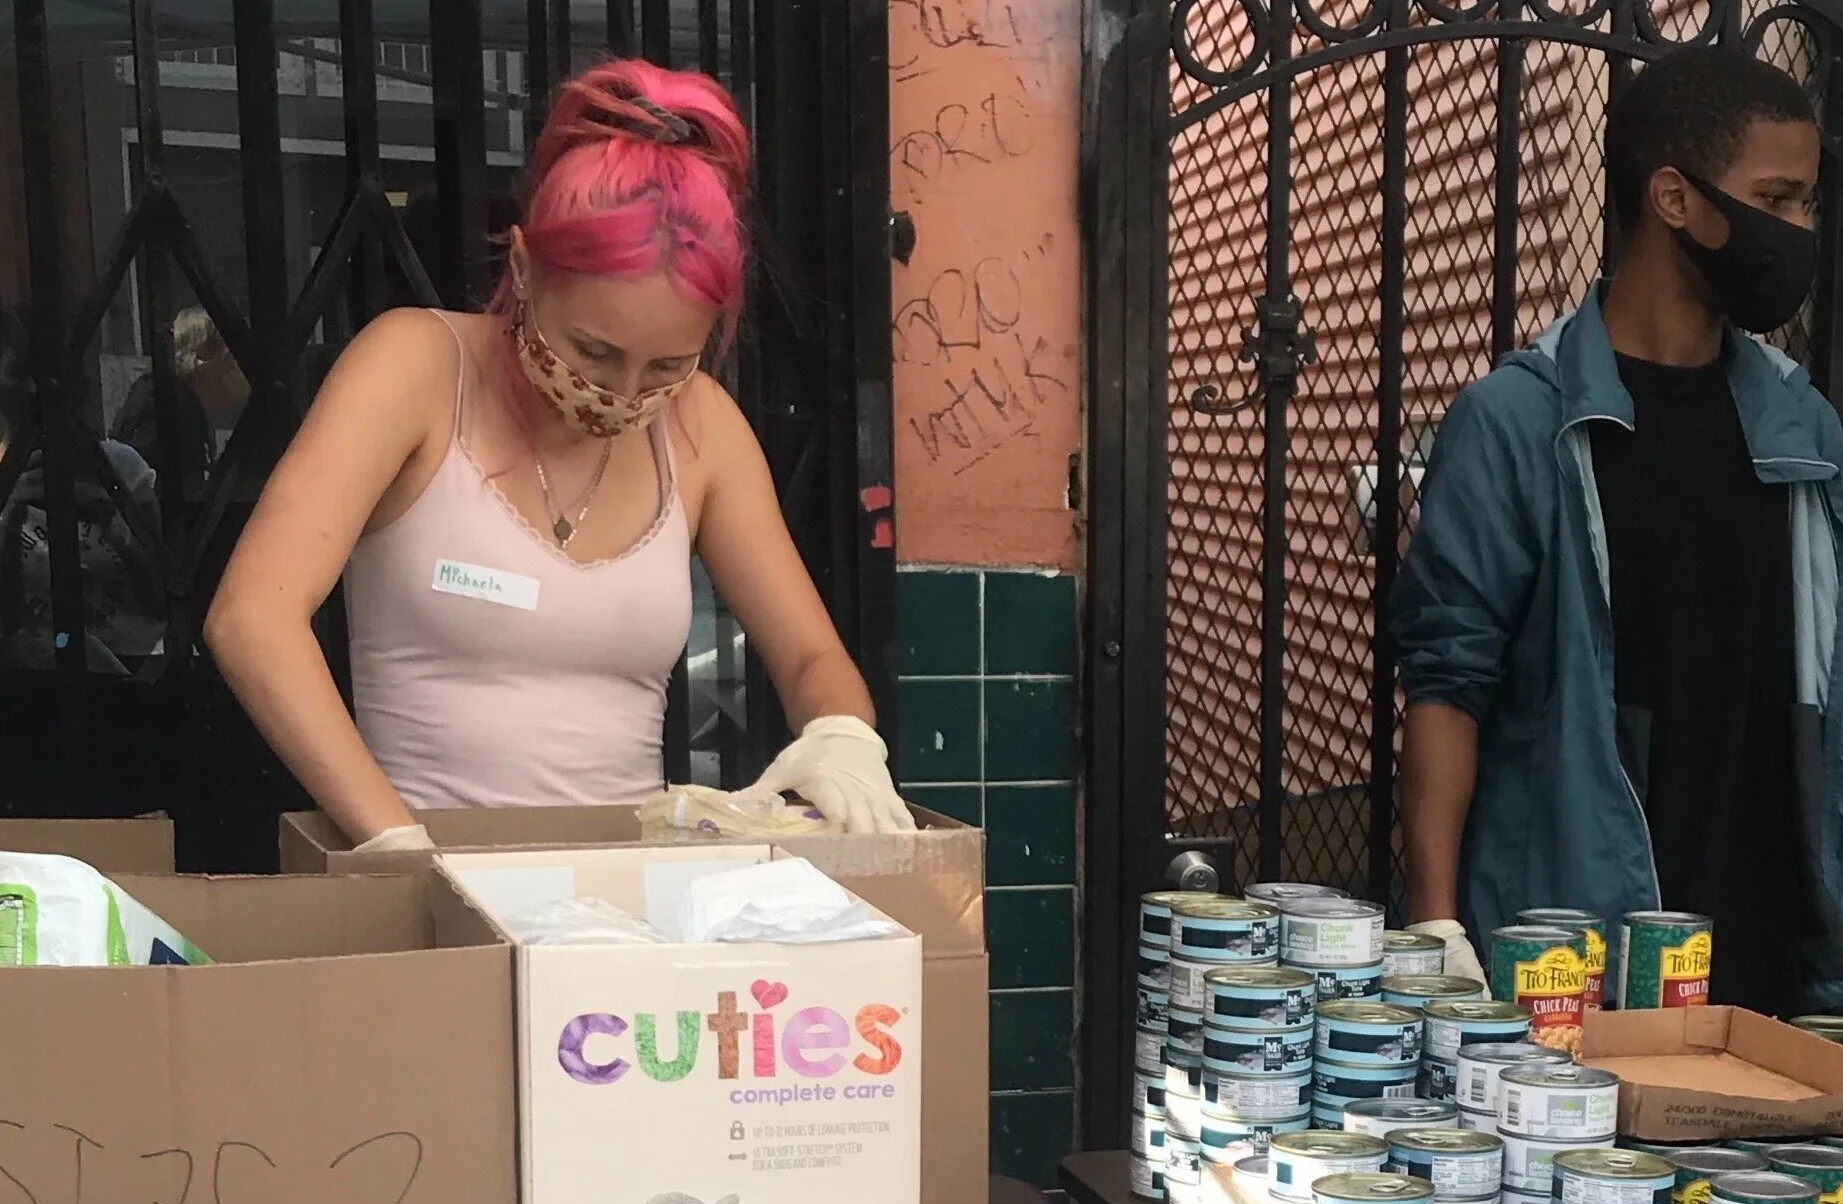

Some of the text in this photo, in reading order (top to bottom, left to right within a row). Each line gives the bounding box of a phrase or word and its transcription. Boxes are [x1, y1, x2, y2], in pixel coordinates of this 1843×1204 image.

[439, 564, 502, 592] Michaela
[1533, 999, 1560, 1014] CHICK
[558, 979, 901, 1085] cuties
[729, 1082, 895, 1106] complete care
